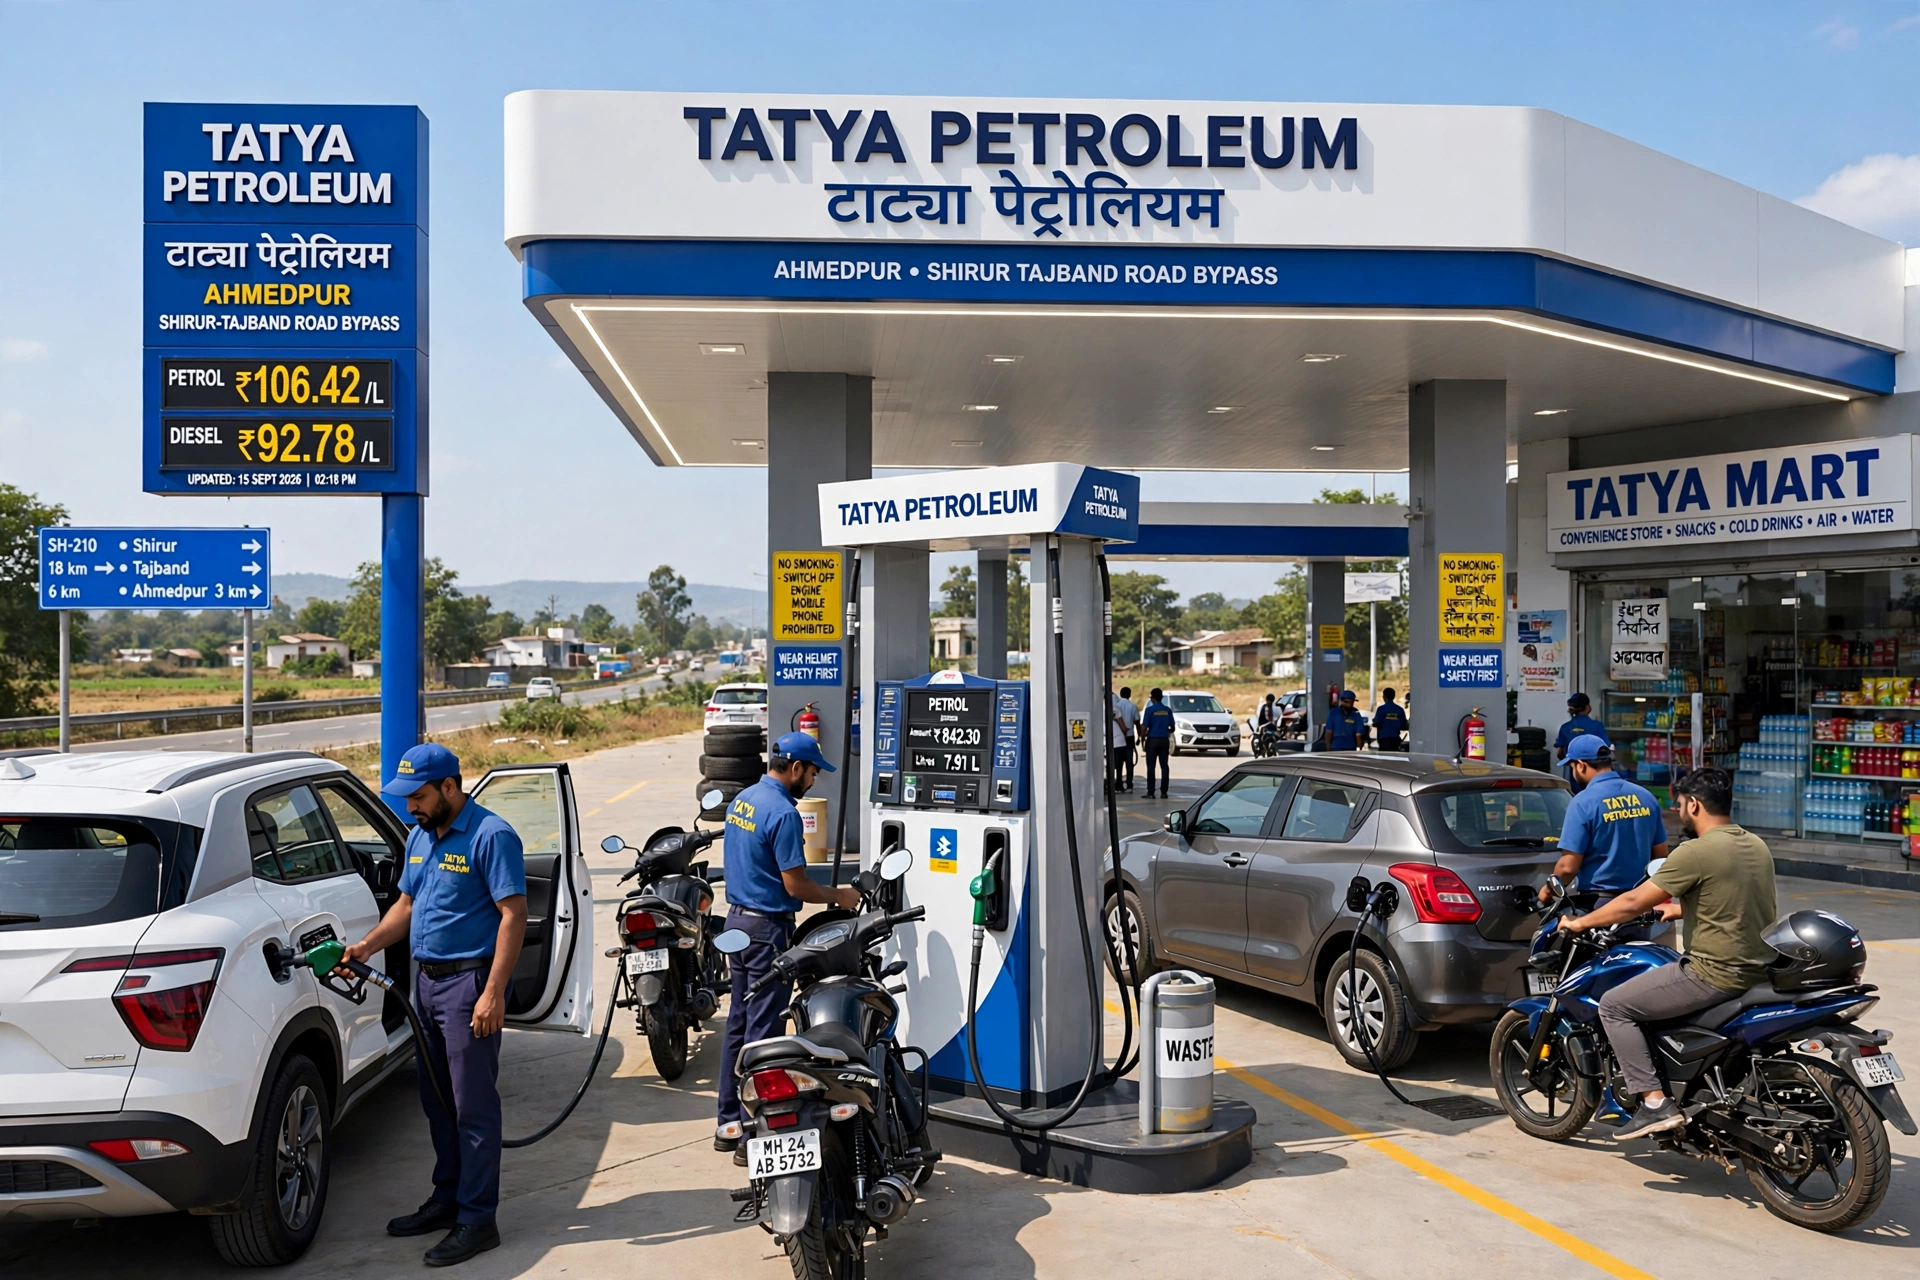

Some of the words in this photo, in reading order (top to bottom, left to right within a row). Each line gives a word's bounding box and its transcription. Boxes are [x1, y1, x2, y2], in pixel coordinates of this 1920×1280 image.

[202, 123, 354, 163] TATYA
[683, 106, 908, 164] TATYA
[931, 111, 1359, 170] PETROLEUM
[163, 171, 392, 204] PETROLEUM
[824, 183, 972, 225] टाट्या
[990, 170, 1225, 238] पेट्रोलियम
[164, 241, 249, 268] टाट्या
[256, 232, 392, 276] पेट्रोलियम
[773, 260, 902, 280] AHMEDPUR
[926, 262, 1010, 282] SHIRUR
[1016, 263, 1118, 283] TAJBAND
[1124, 265, 1187, 284] ROAD
[1193, 266, 1279, 286] BYPASS
[203, 283, 351, 306] AHMEDPUR
[159, 314, 291, 332] SHIRUR-TAJBAND
[294, 315, 338, 331] ROAD
[341, 315, 400, 332] BYPASS
[168, 368, 225, 388] PETROL
[235, 364, 361, 404] ₹106.42
[365, 381, 384, 404] /L
[170, 426, 223, 445] DIESEL
[237, 422, 356, 464] ₹92.78
[360, 440, 380, 463] /L
[187, 473, 236, 486] UPDATED:
[237, 474, 250, 486] 15
[251, 474, 277, 486] SEPT
[341, 474, 357, 486] PM
[1567, 466, 1711, 521] TATYA
[1726, 448, 1880, 509] MART
[1092, 485, 1119, 504] TATYA
[838, 499, 900, 526] TATYA
[904, 487, 1038, 522] PETROLEUM
[1560, 528, 1628, 546] CONVENIENCE
[1630, 526, 1663, 541] STORE
[1675, 521, 1716, 538] SNACKS
[1729, 519, 1759, 534] COLD
[1761, 515, 1803, 532] DRINKS
[1816, 512, 1837, 528] AIR
[1851, 508, 1894, 526] WATER
[47, 537, 98, 553] SH-210
[132, 537, 178, 553] Shirur
[48, 560, 64, 576] 18
[67, 560, 88, 576] km
[132, 560, 190, 579] Tajband
[778, 558, 792, 569] NO
[794, 558, 835, 570] SMOKING
[1443, 560, 1456, 570] NO
[783, 572, 817, 583] SWITCH
[818, 573, 835, 583] OFF
[1481, 574, 1496, 584] OFF
[48, 584, 57, 599] 6
[61, 585, 81, 599] km
[132, 583, 208, 601] Ahmedpur
[214, 583, 224, 599] 3
[228, 584, 247, 599] km
[792, 611, 824, 621] PHONE
[782, 624, 835, 635] PROHIBITED
[778, 652, 803, 665] WEAR
[805, 652, 838, 665] HELMET
[1443, 654, 1467, 667] WEAR
[1468, 654, 1499, 667] HELMET
[782, 668, 814, 680] SAFETY
[815, 667, 838, 680] FIRST
[1446, 669, 1476, 682] SAFETY
[1477, 669, 1499, 682] FIRST
[928, 696, 969, 712] PETROL
[943, 753, 967, 772] 7.91
[971, 755, 980, 772] L
[1602, 794, 1641, 810] TATYA
[1166, 1036, 1214, 1062] WASTE
[763, 1138, 783, 1156] MH
[787, 1135, 806, 1153] 24
[755, 1157, 775, 1176] AB
[779, 1151, 816, 1171] 5732
